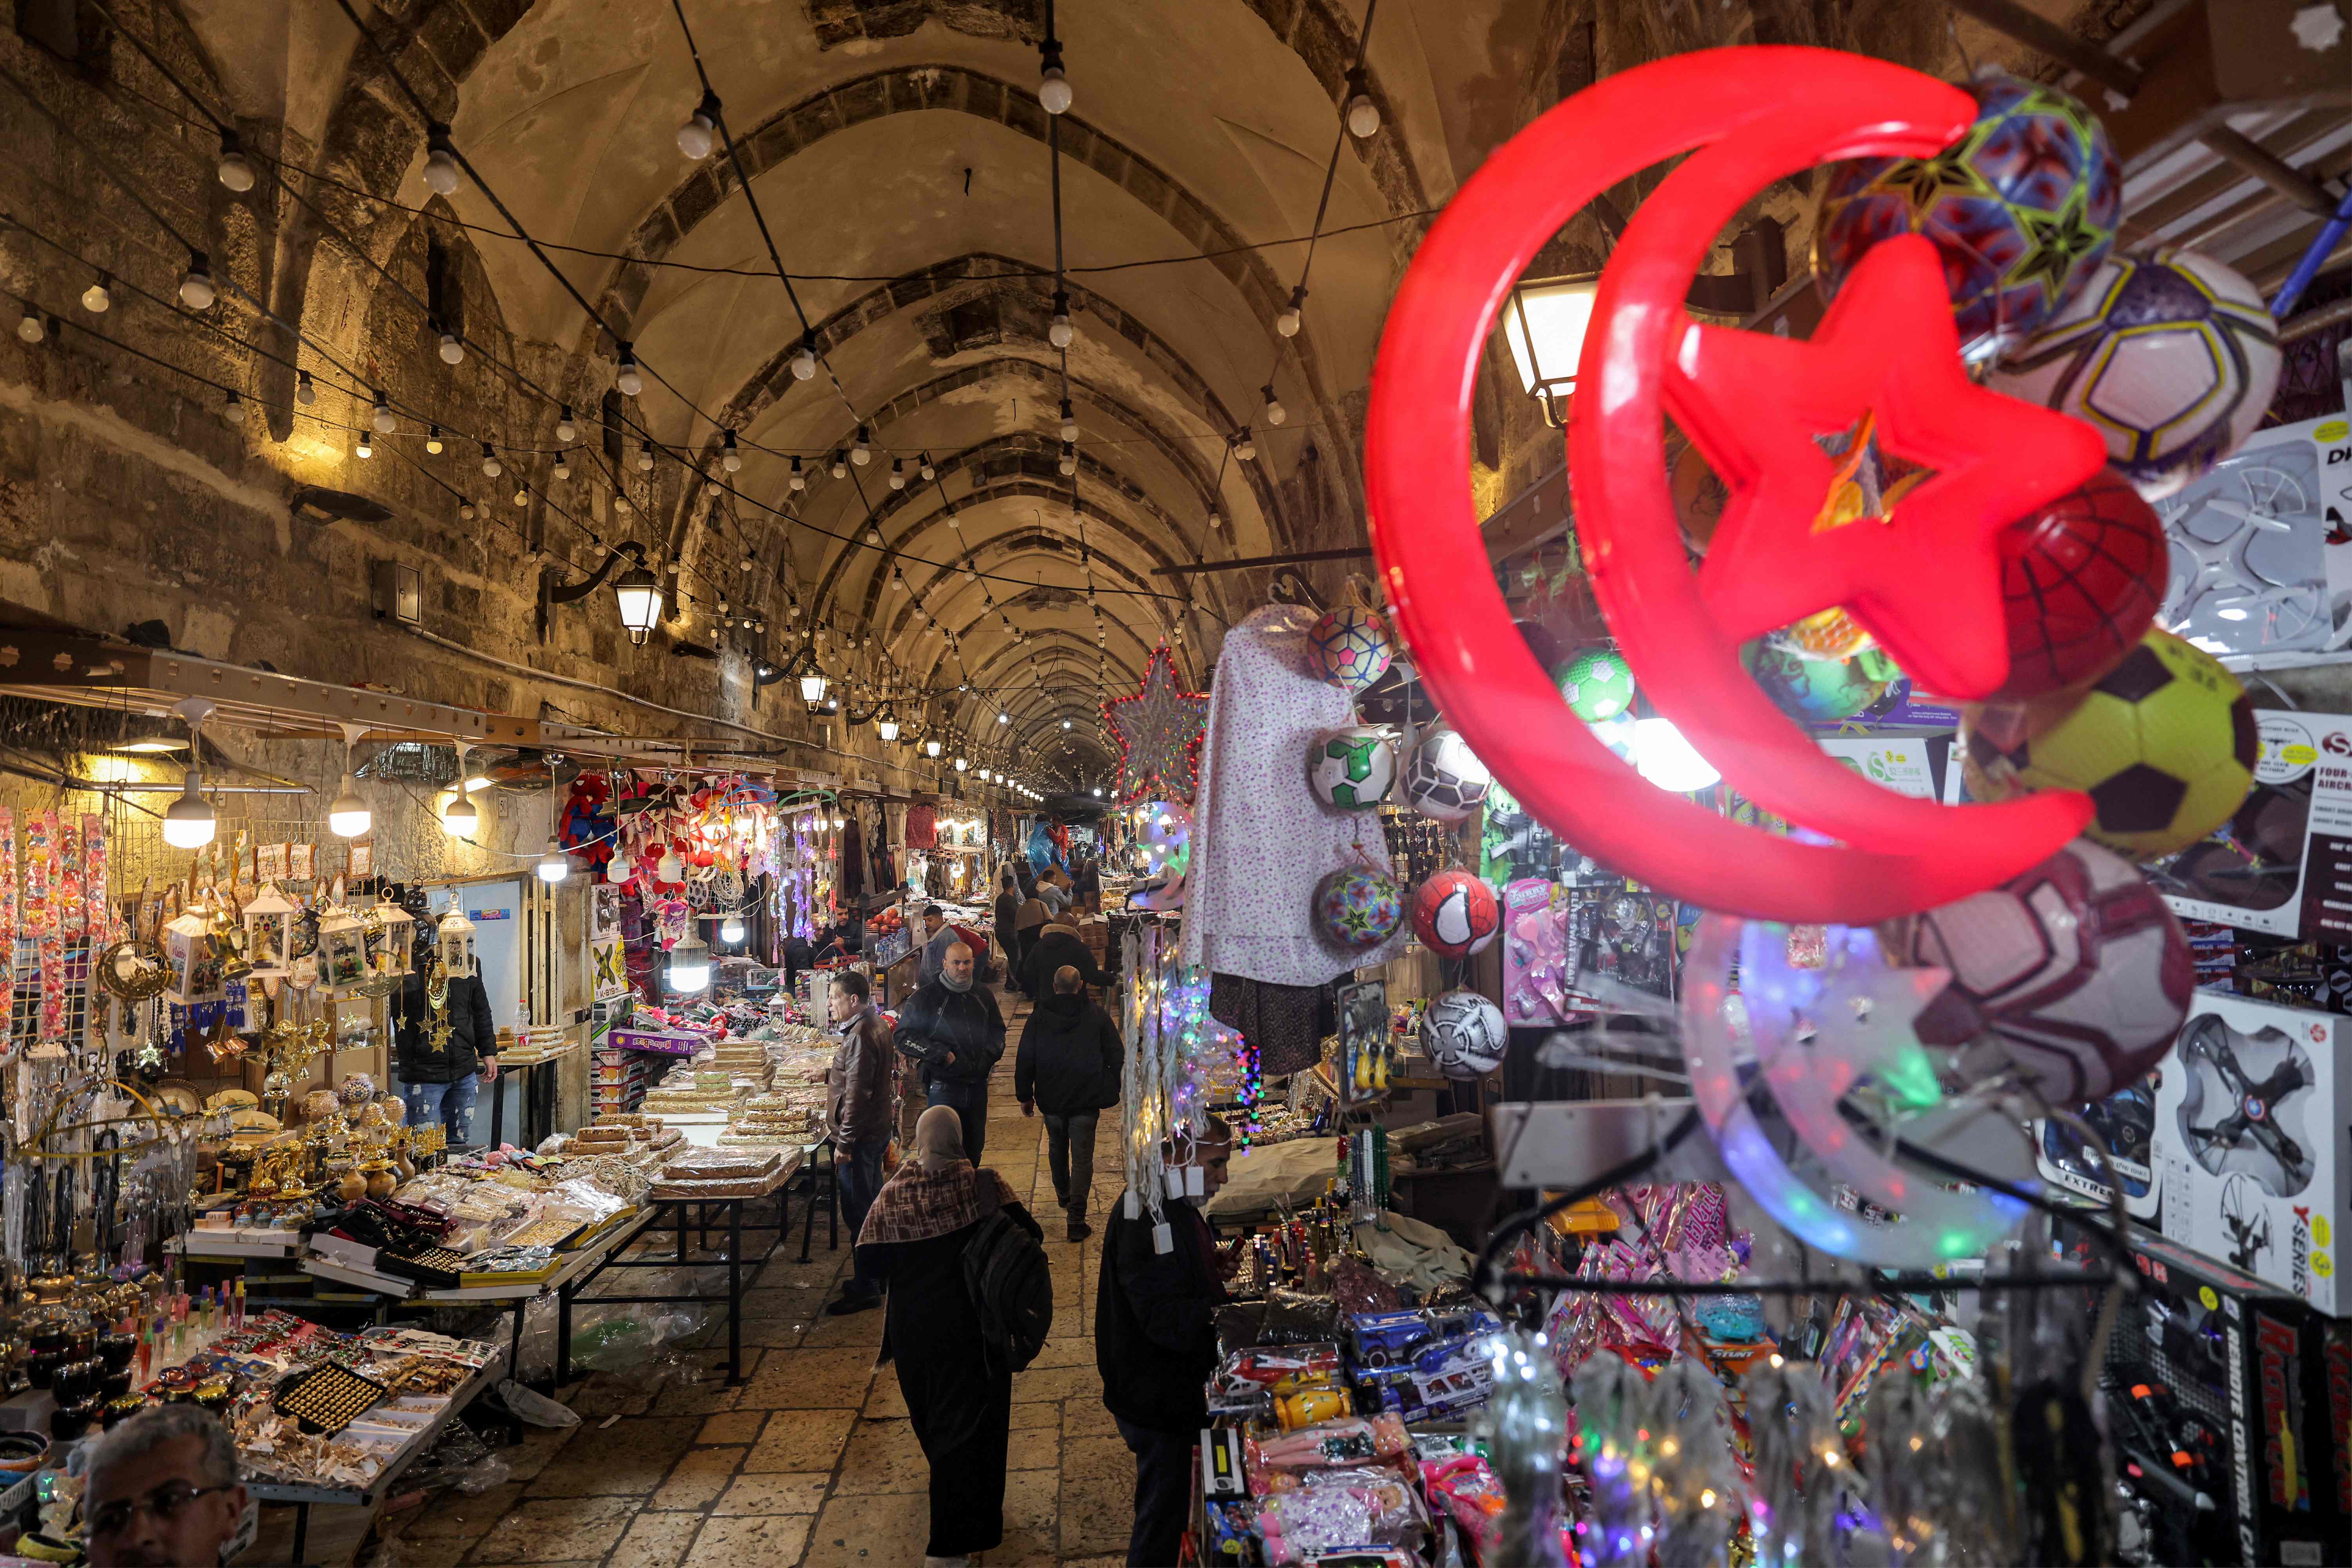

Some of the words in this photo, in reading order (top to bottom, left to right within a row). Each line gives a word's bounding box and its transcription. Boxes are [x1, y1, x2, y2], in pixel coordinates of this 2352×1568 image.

[500, 800, 507, 812] 50
[1710, 1348, 1755, 1358] STUNT
[2232, 1419, 2251, 1520] CONTROL
